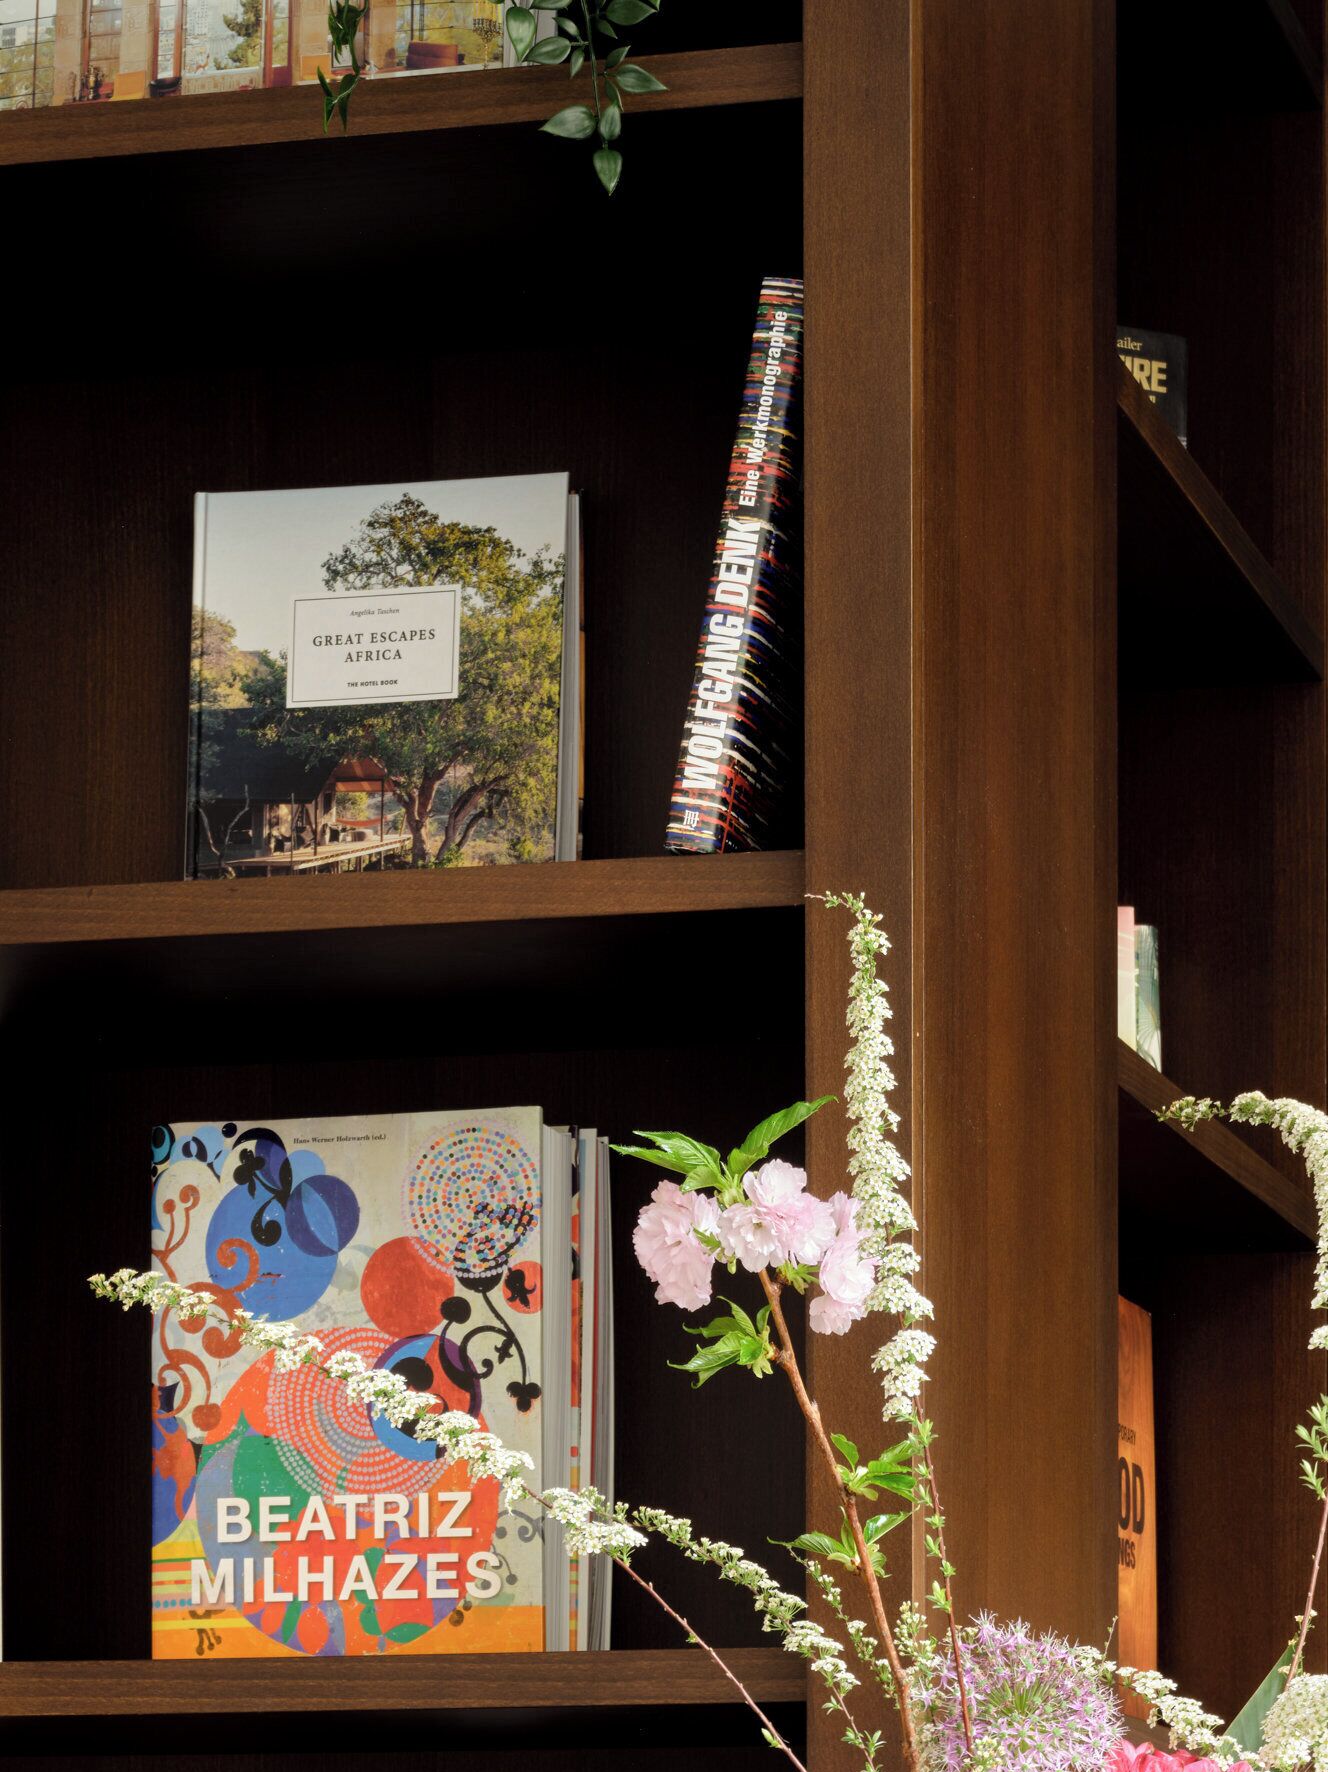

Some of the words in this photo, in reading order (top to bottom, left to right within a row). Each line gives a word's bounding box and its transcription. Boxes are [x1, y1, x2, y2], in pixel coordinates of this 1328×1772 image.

[746, 310, 788, 464] Werkmonographie
[738, 469, 760, 507] Eine
[349, 609, 375, 618] Angelika
[377, 608, 400, 616] Taschen
[312, 633, 364, 647] GREAT
[370, 628, 436, 644] ESCAPES
[344, 649, 403, 663] AFRICA
[682, 612, 745, 790] WOLFGANG
[714, 518, 761, 604] DENK
[216, 1491, 473, 1543] BEATRIZ
[190, 1551, 502, 1605] MILHAZES
